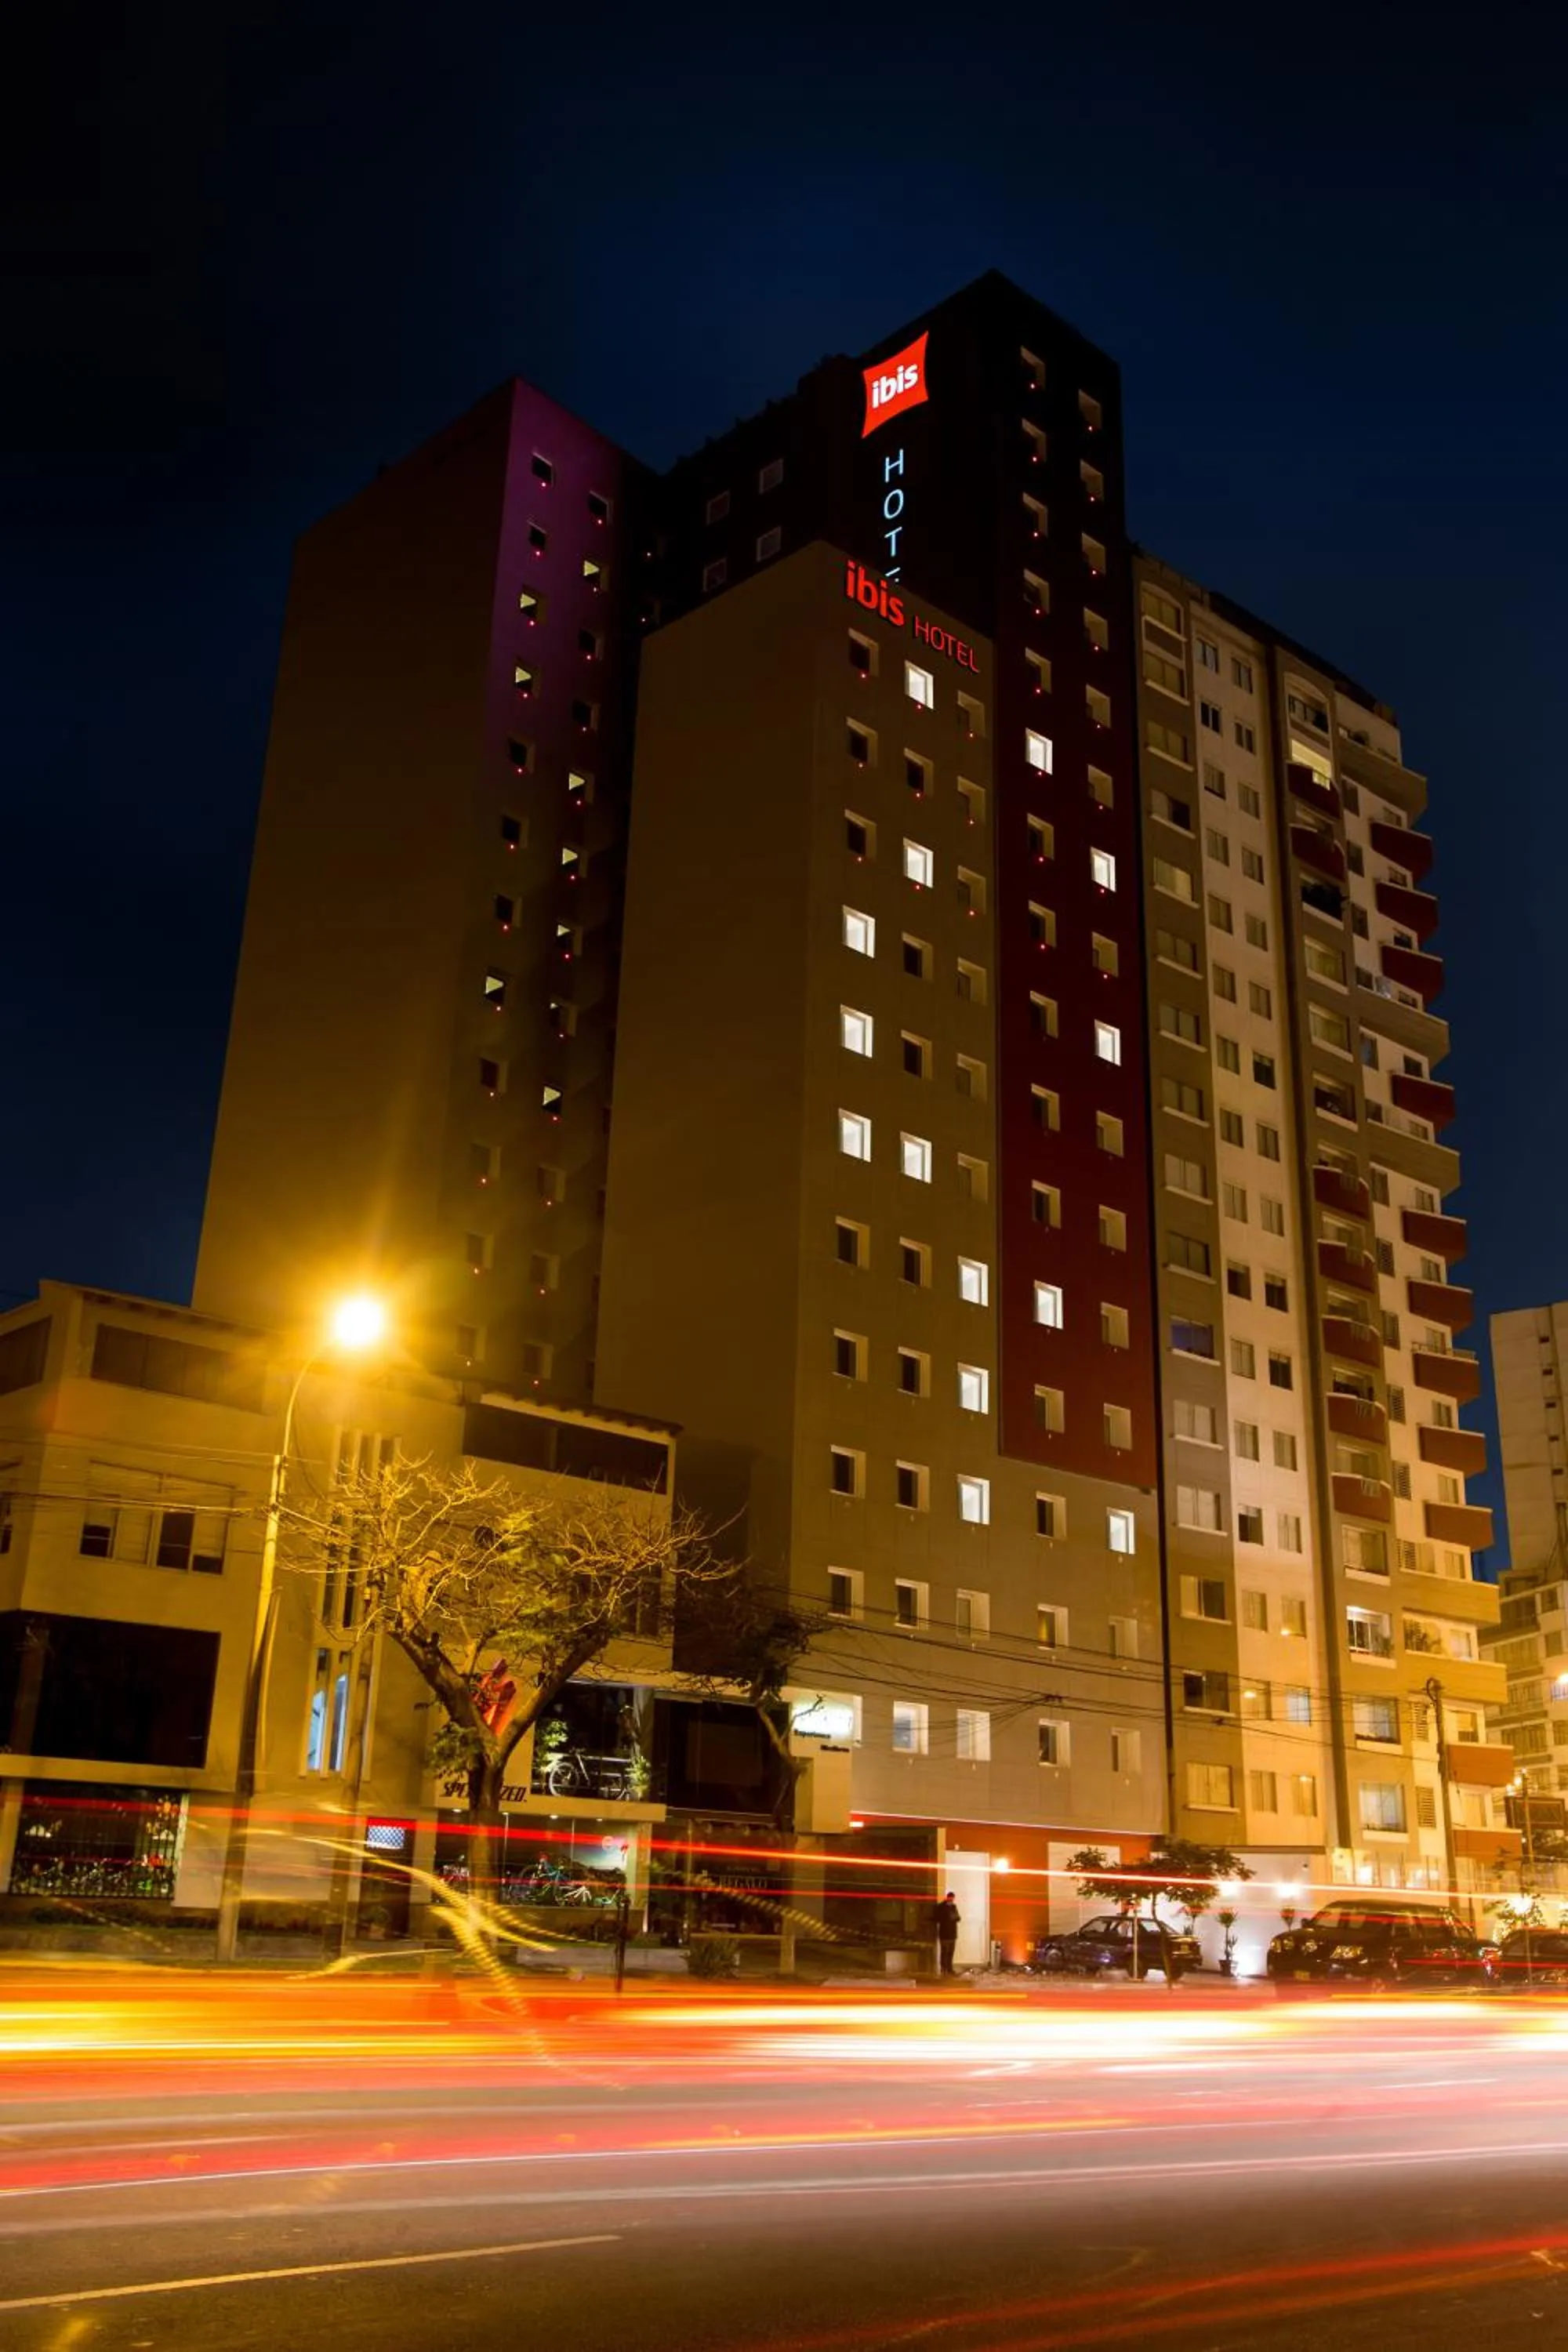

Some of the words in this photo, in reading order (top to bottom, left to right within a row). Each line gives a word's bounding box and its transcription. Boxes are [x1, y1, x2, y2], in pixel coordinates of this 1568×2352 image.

[872, 364, 918, 408] ibis
[884, 448, 904, 583] HOT
[846, 560, 904, 626] ibis
[914, 615, 979, 673] HOTEL
